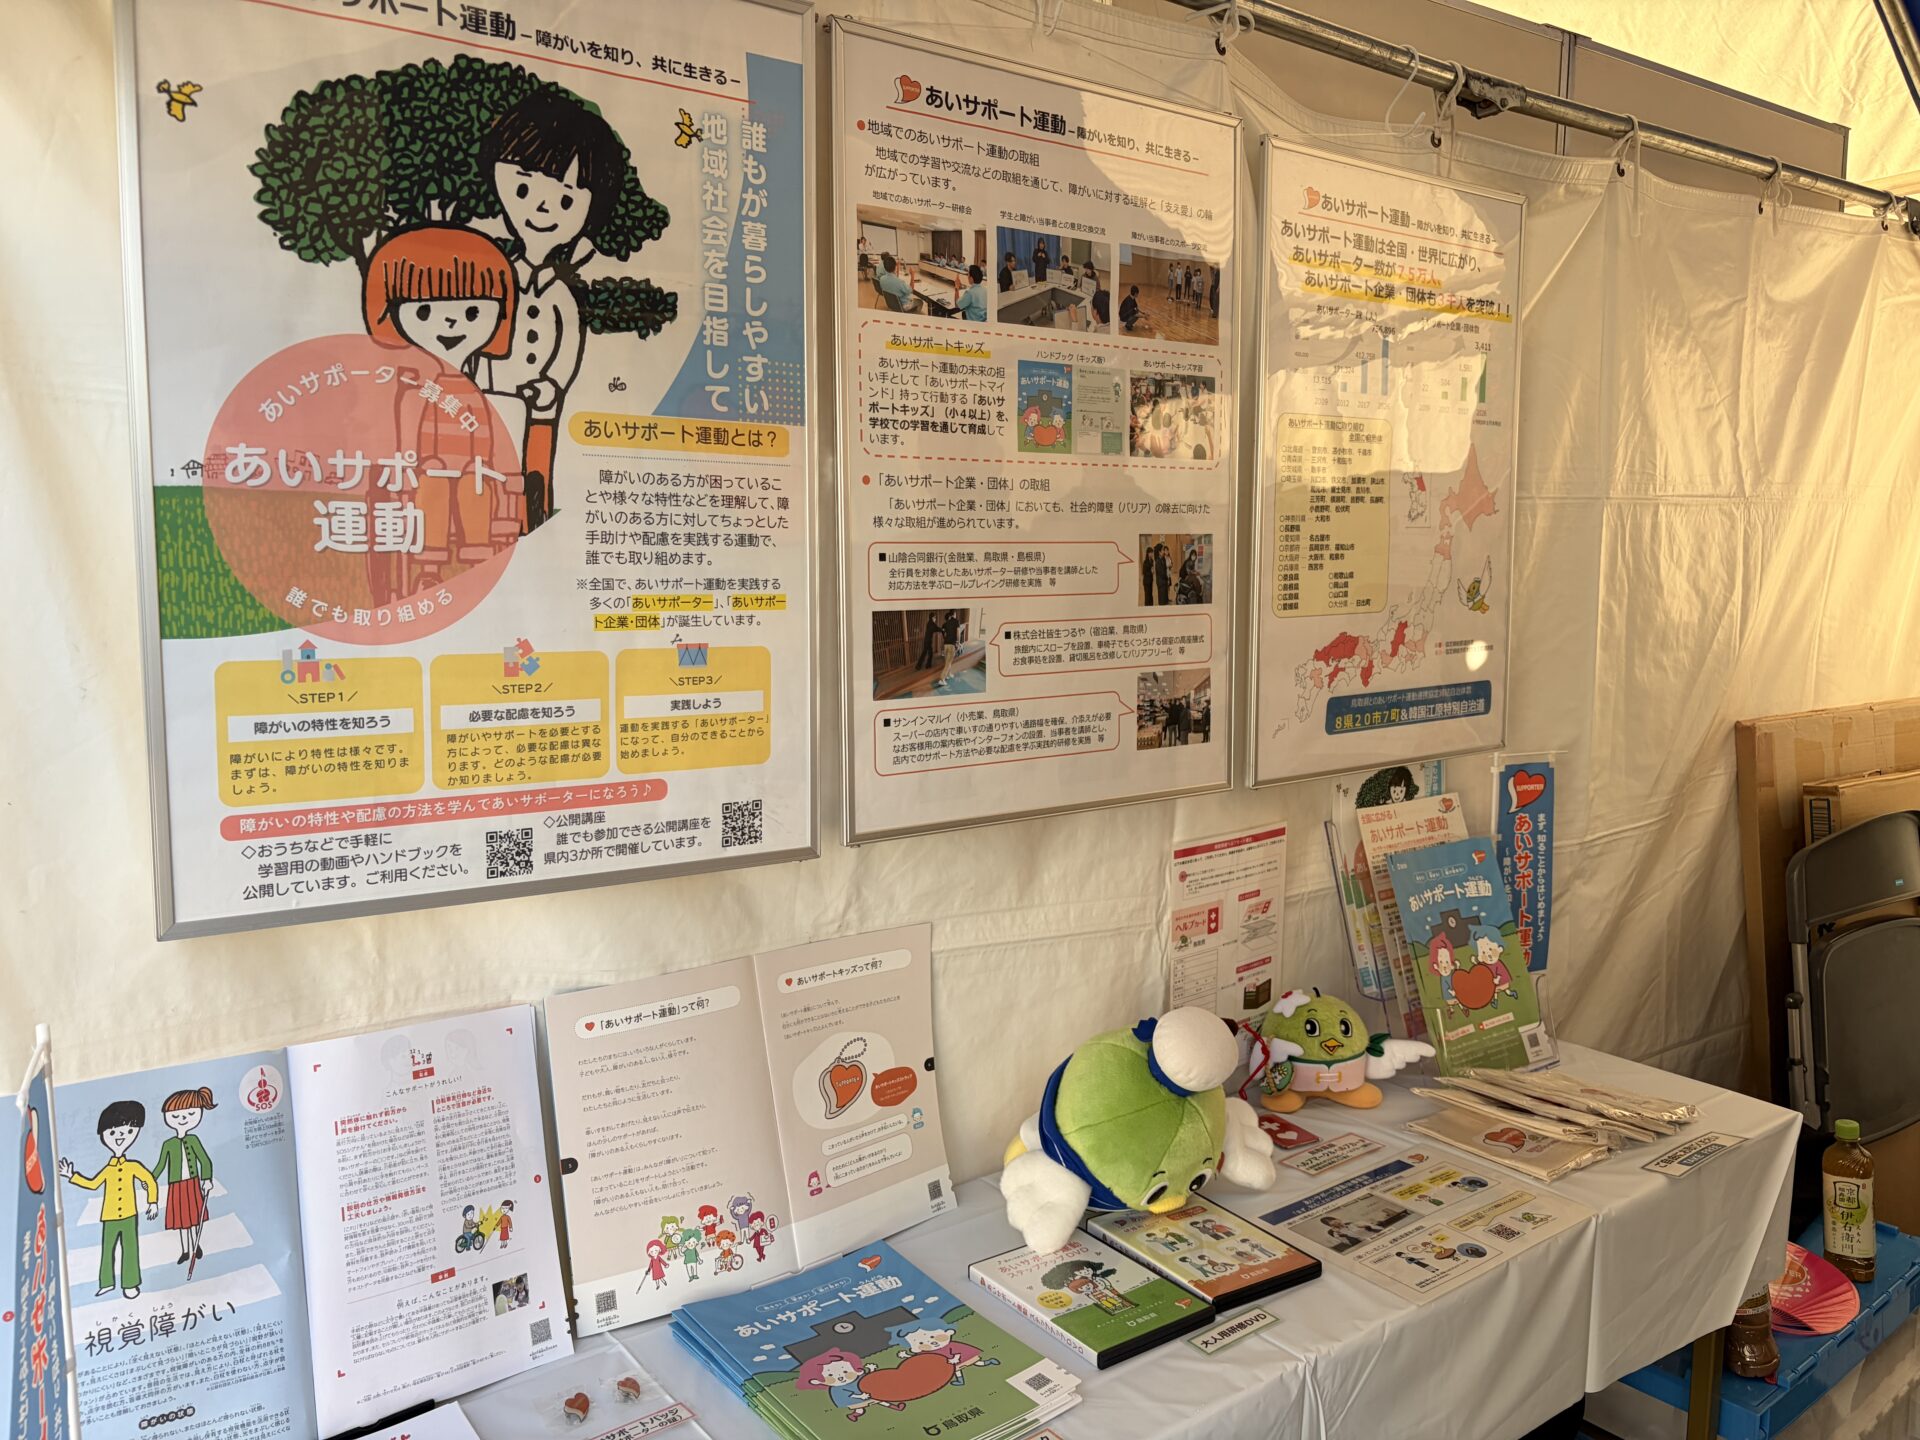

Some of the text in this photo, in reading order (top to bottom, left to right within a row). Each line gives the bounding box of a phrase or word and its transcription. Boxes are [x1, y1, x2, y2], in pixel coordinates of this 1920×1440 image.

[925, 85, 1066, 136] あいサポート運動
[867, 118, 1040, 167] 地域でのあいサポート運動の取組
[864, 163, 957, 191] が広がっています。
[1321, 193, 1411, 227] あいサポート運動
[1280, 219, 1481, 272] あいサポート運動は全国・世界に広がり、
[702, 112, 730, 413] 地域社会を目指して
[741, 120, 769, 414] 誰もが暮らしやすい
[890, 334, 985, 355] あいサポートキッズ
[878, 357, 1006, 379] あいサポート運動の未来の担
[258, 362, 479, 433] あいサポーター募集中
[869, 417, 1005, 437] 学校での学習を通じて育成して
[869, 434, 905, 446] います。
[224, 443, 507, 496] あいサポート
[599, 469, 782, 490] 障がいのある方が困っているこ
[585, 489, 790, 511] とや様々な特性などを理解して、障
[312, 500, 426, 554] 運動
[585, 510, 789, 529] がいのある方に対してちょっとした
[873, 516, 1020, 529] 様々な取組が進められています。
[585, 530, 777, 548] 手助けや配慮を実践する運動で、
[585, 551, 713, 566] 誰でも取り組めます。
[576, 578, 781, 592] ※全国で、あいサポート運動を実践する
[285, 586, 453, 627] 誰でも取り組める
[468, 705, 576, 722] 必要な配慮を知ろう
[670, 698, 722, 712] 実践しよう
[254, 715, 391, 735] 障がいの特性を知ろう
[446, 724, 601, 744] 障がいやサポートを必要とする
[620, 727, 765, 745] になって、自分のできることから
[230, 743, 404, 765] 障がいにより特性は様々です。
[447, 738, 601, 758] 方によって、必要な配慮は異な
[620, 748, 685, 760] 始めましょう。
[231, 757, 409, 780] まずは、障がいの特性を知りま
[447, 751, 602, 772] ります。どのような配慮が必要
[232, 782, 277, 796] しょう。
[447, 773, 532, 787] か知りましょう。
[556, 816, 711, 846] 誰でも参加できる公開講座を
[1370, 815, 1449, 844] あいサポート運動
[257, 843, 463, 878] 学習用の動画やハンドブックを
[242, 865, 469, 900] 公開しています。ご利用ください。
[1408, 880, 1492, 912] あいサポート運動
[1175, 918, 1207, 932] ヘルプカード
[255, 1101, 273, 1112] SOS
[1840, 1210, 1855, 1254] 伊右衛門
[733, 1276, 903, 1338] あいサポート運動
[85, 1302, 235, 1358] 視覚障がい
[1200, 1312, 1268, 1349] 大人用研修DVD
[942, 1406, 986, 1432] 鳥取県
